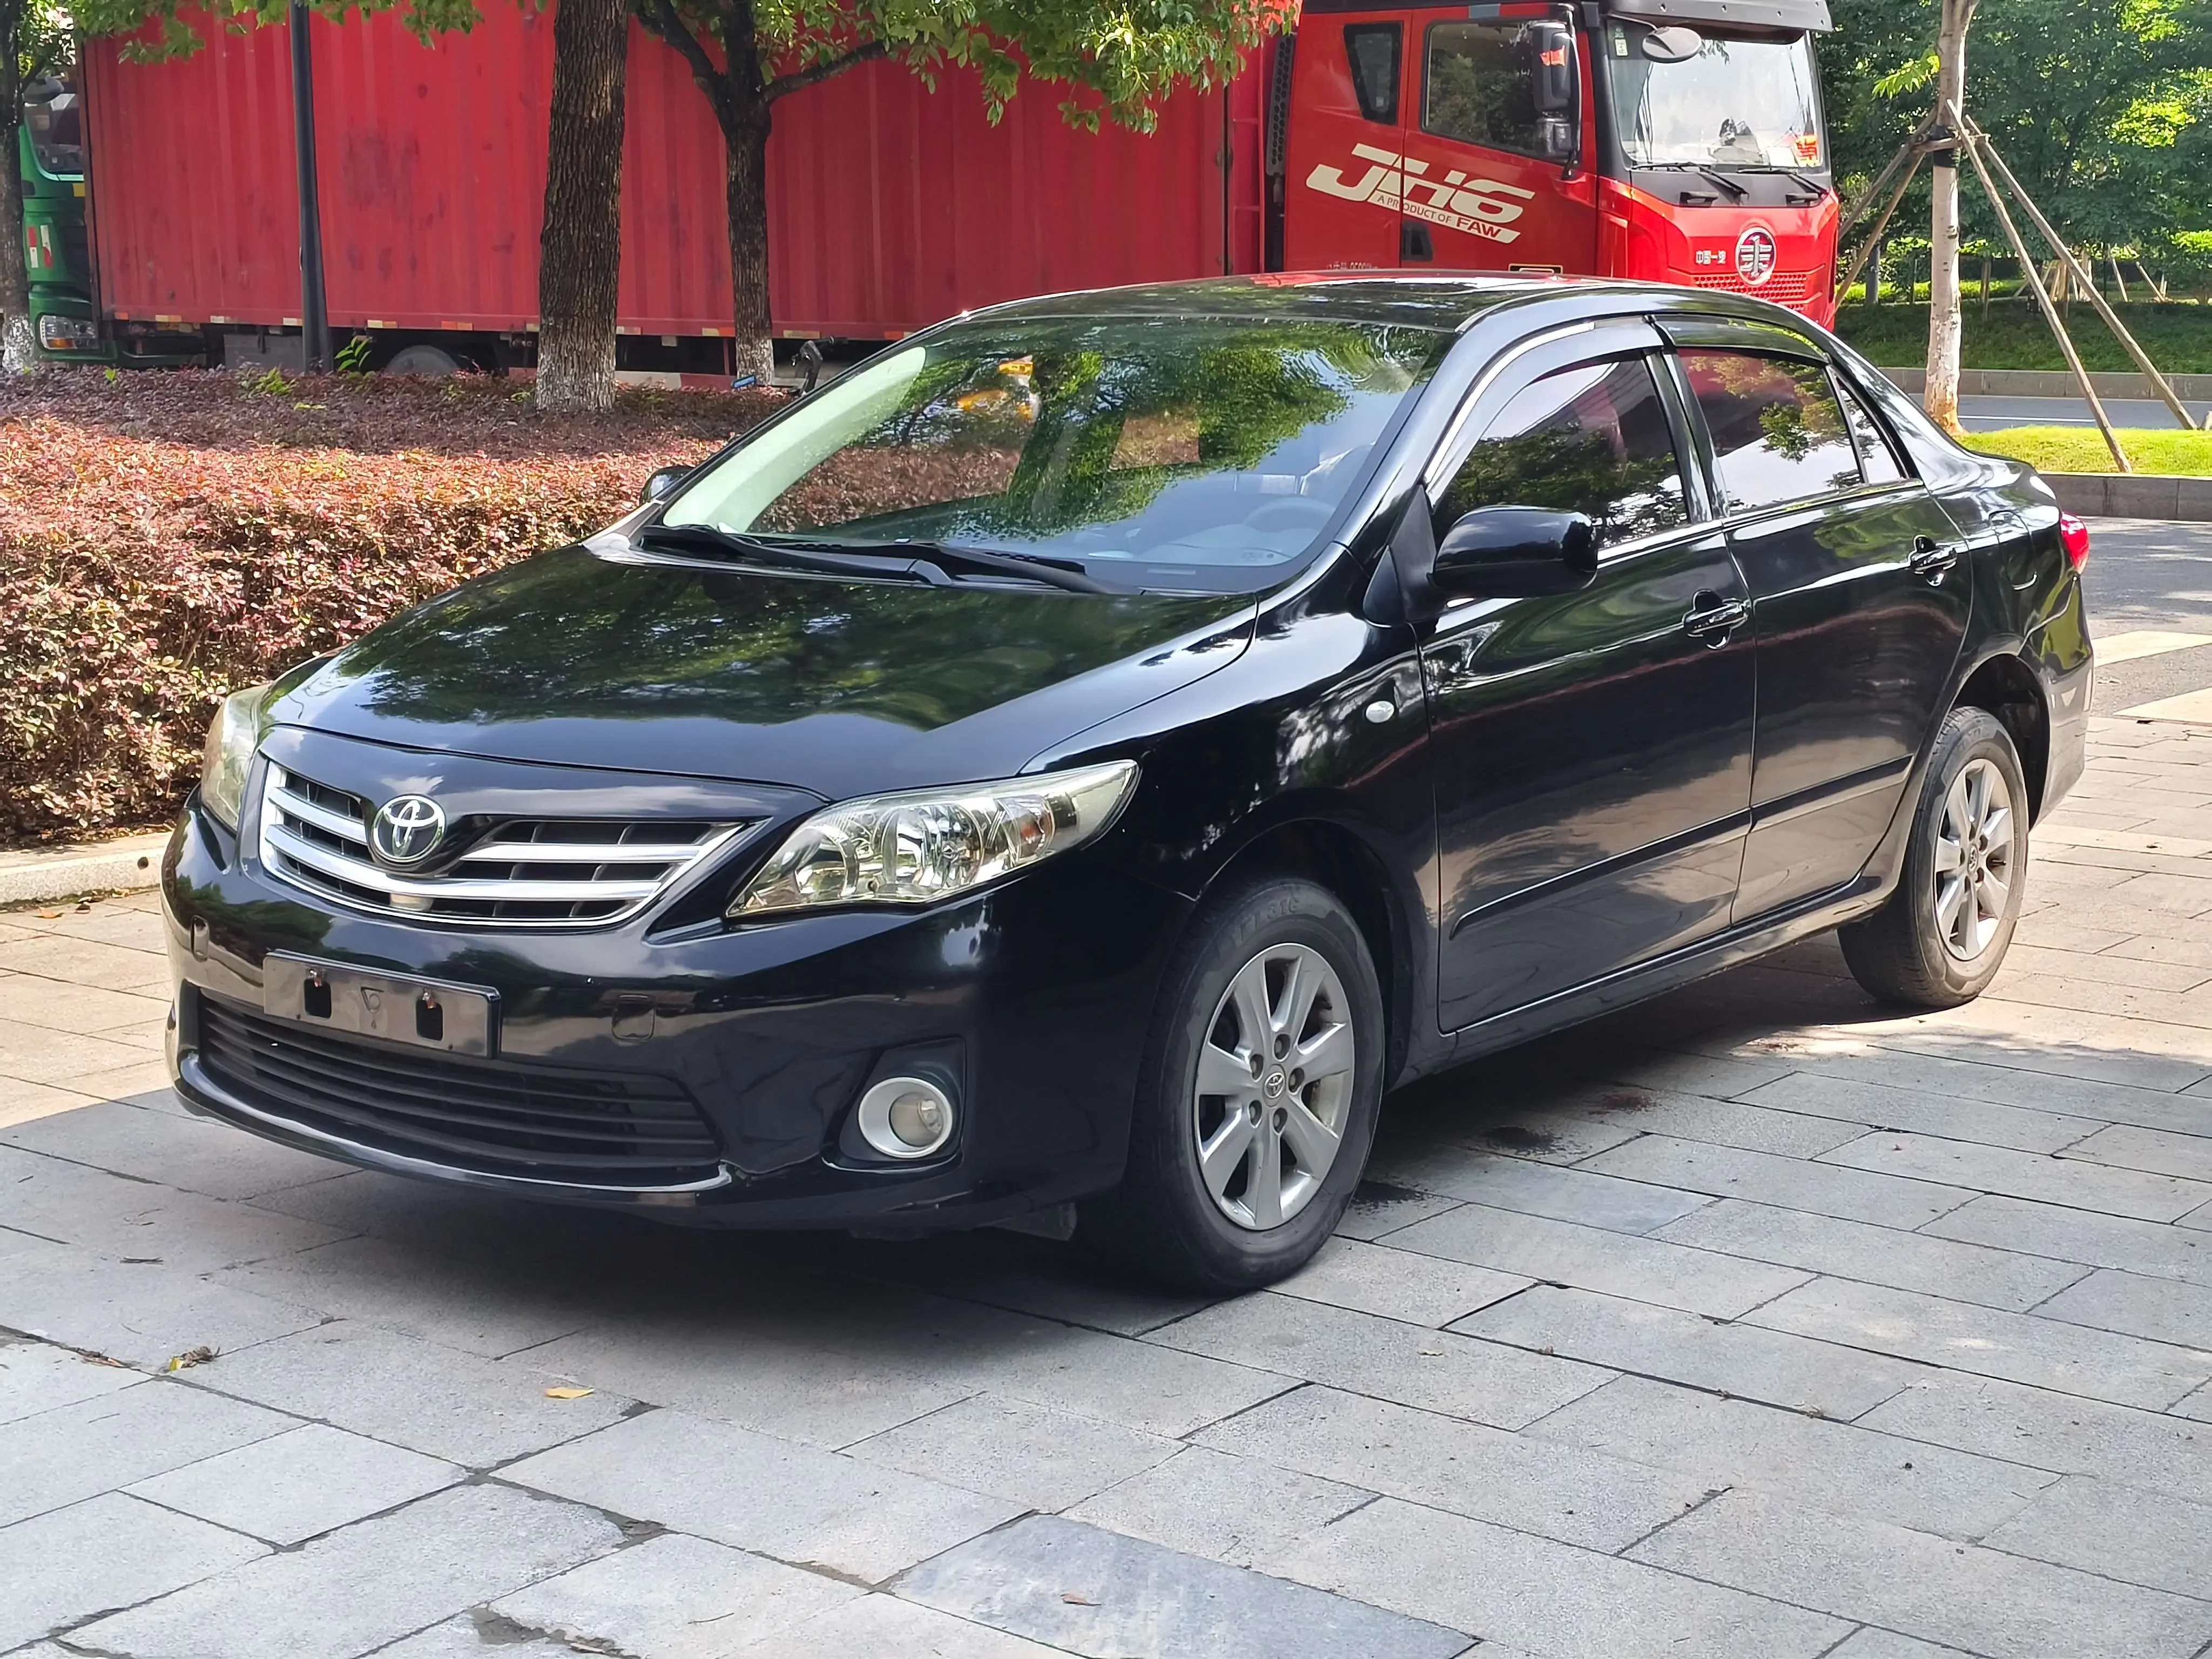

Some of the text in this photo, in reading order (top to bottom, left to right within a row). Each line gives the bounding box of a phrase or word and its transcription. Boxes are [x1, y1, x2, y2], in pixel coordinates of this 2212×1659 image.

[1306, 143, 1535, 223] JH6
[1377, 194, 1502, 238] A PRODUCT OF FAW
